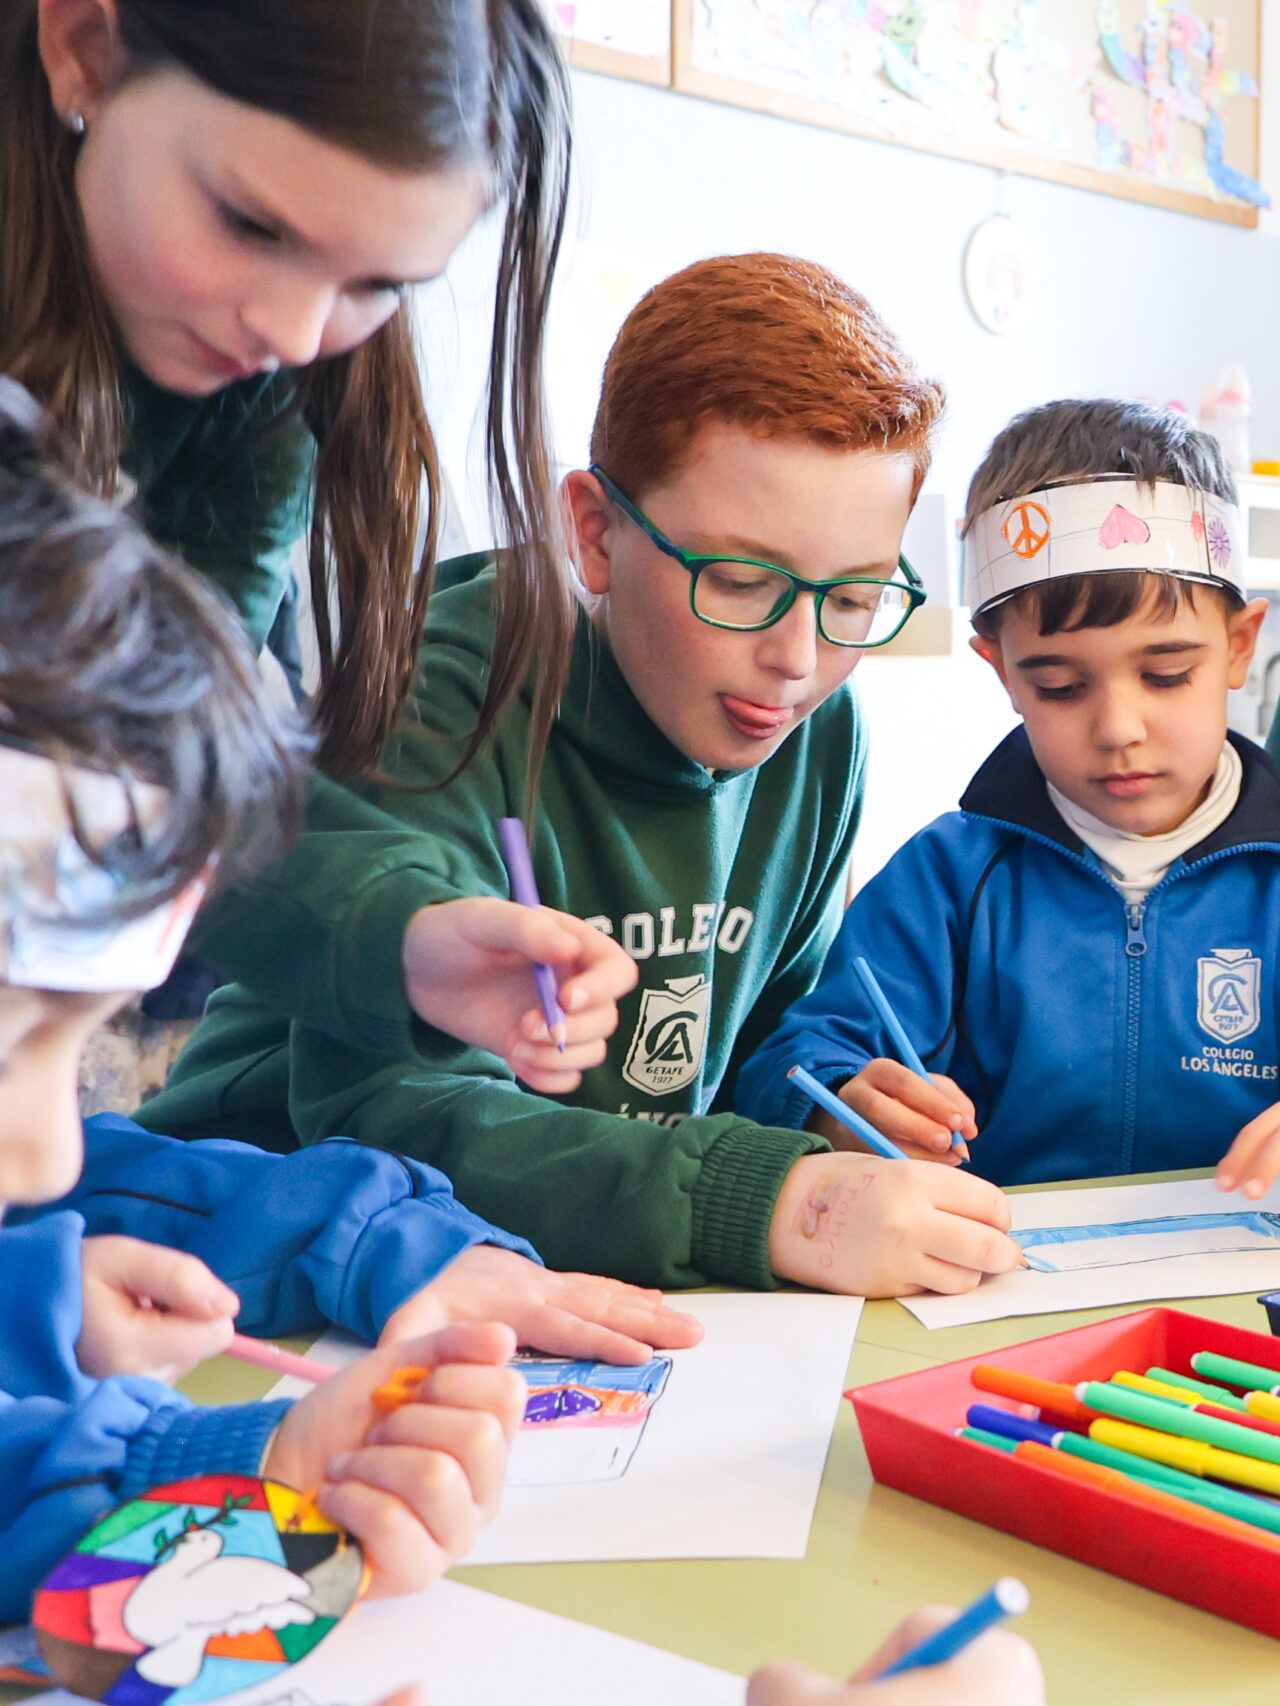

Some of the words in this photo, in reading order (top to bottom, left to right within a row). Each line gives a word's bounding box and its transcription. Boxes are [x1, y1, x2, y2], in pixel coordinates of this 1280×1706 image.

[1202, 1047, 1254, 1060] COLEGIO
[645, 1065, 685, 1077] GETAFE
[1181, 1056, 1210, 1073] LOS
[1212, 1059, 1278, 1079] ÁNGELES
[651, 1074, 674, 1085] 1977
